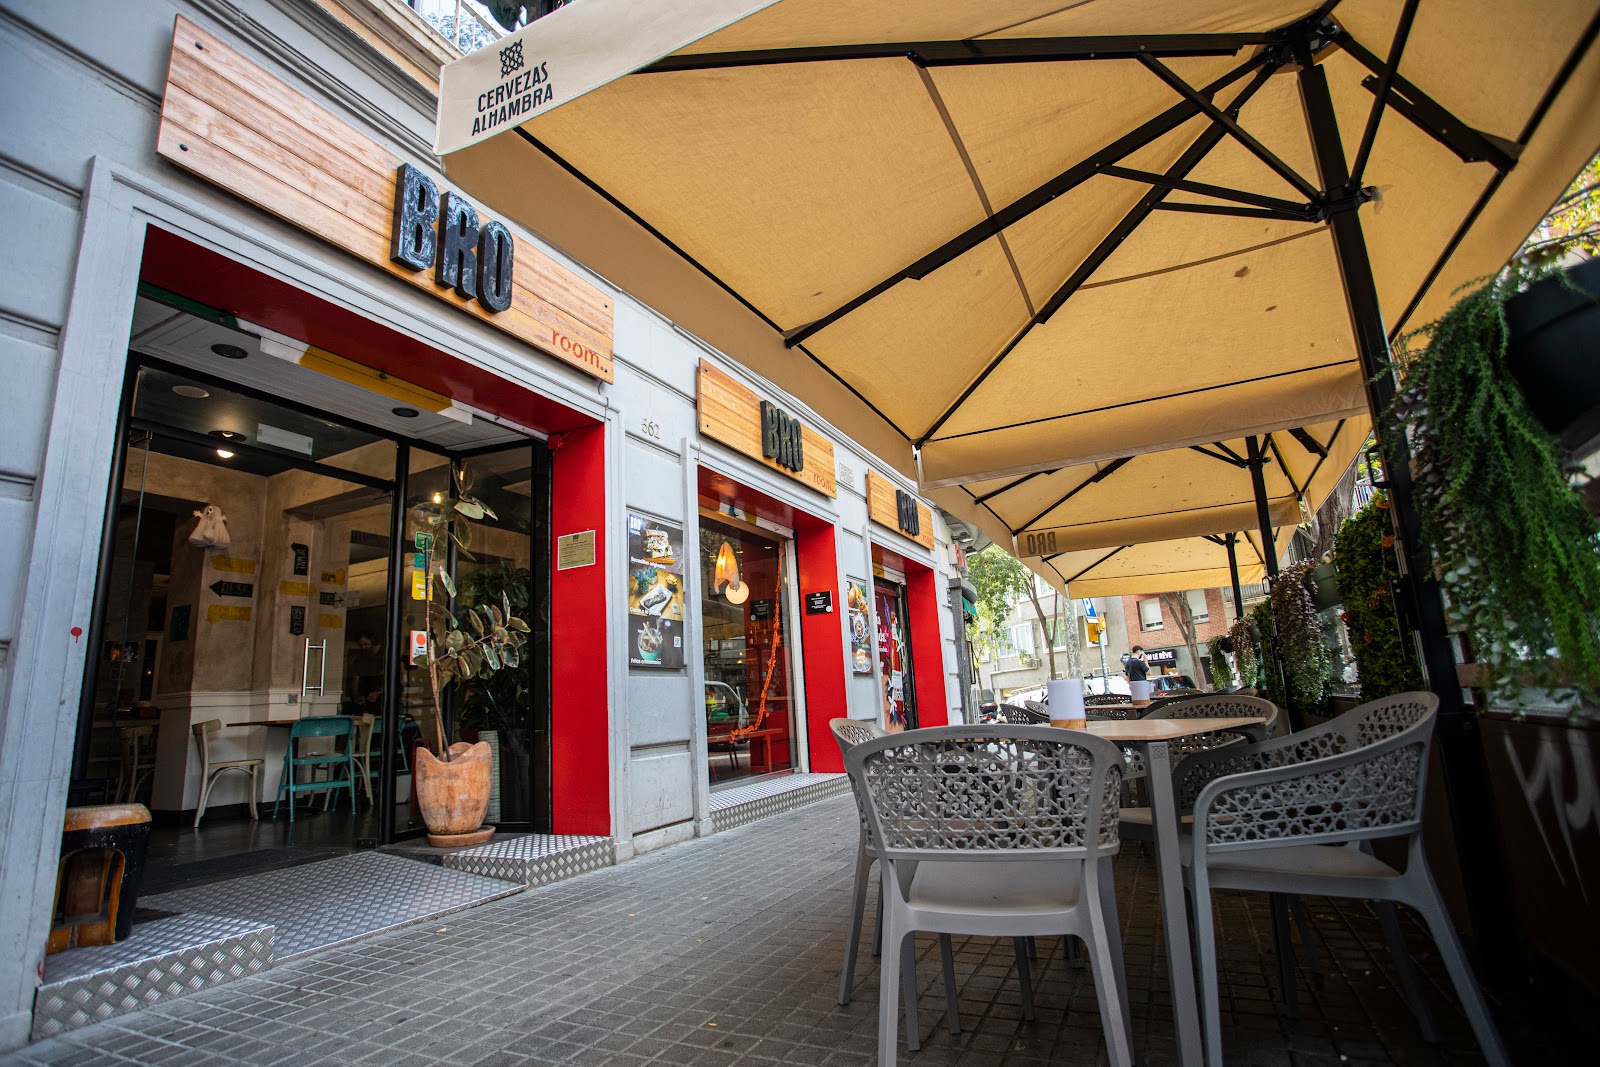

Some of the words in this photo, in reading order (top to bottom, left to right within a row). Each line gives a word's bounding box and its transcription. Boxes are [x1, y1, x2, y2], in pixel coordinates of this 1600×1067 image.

[471, 83, 553, 136] ALHAMBRA
[478, 61, 548, 113] CERVEZAS
[390, 162, 514, 314] BRO
[641, 417, 659, 440] 562
[760, 400, 804, 472] BRO
[896, 490, 919, 536] BRO
[1083, 599, 1091, 615] P
[1153, 652, 1158, 660] LE
